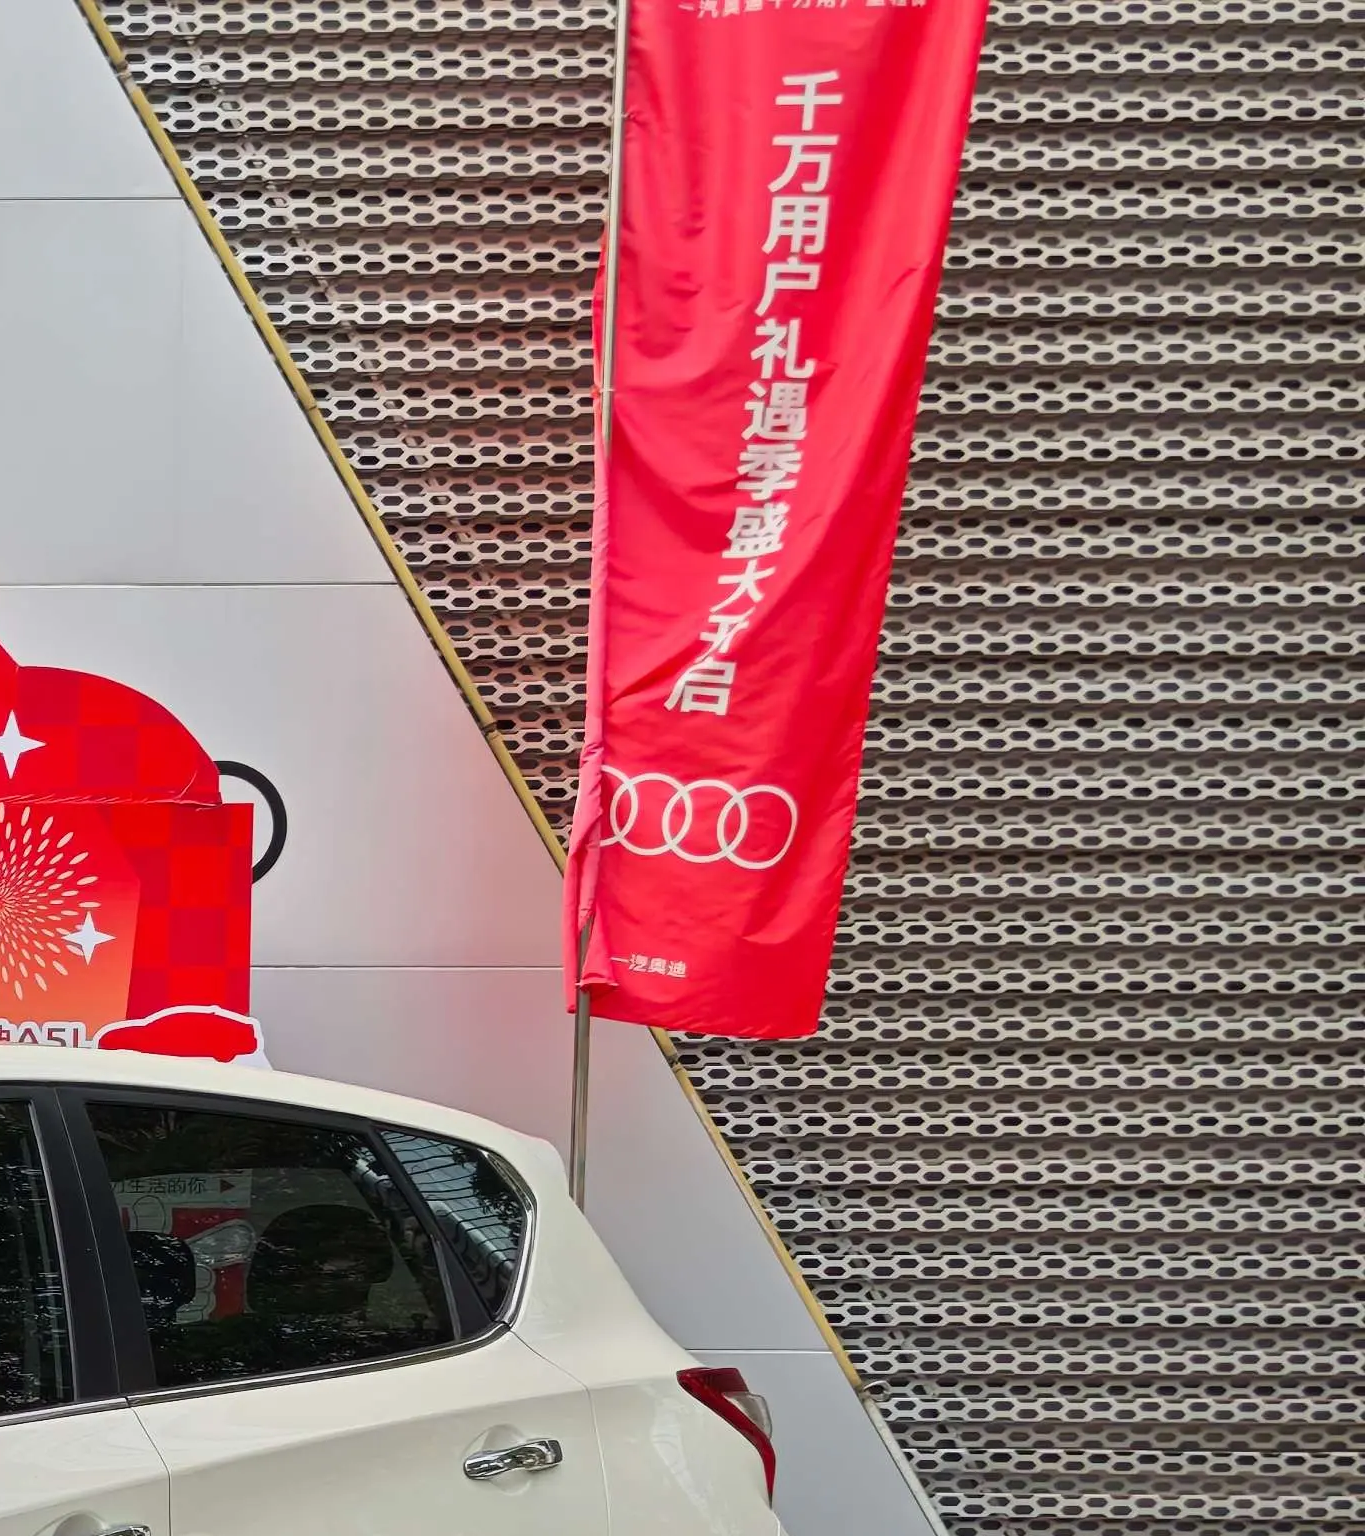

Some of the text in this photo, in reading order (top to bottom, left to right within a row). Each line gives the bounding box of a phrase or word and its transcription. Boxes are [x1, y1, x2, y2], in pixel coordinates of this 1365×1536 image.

[664, 71, 842, 717] 千万用户礼遇季盛大开启
